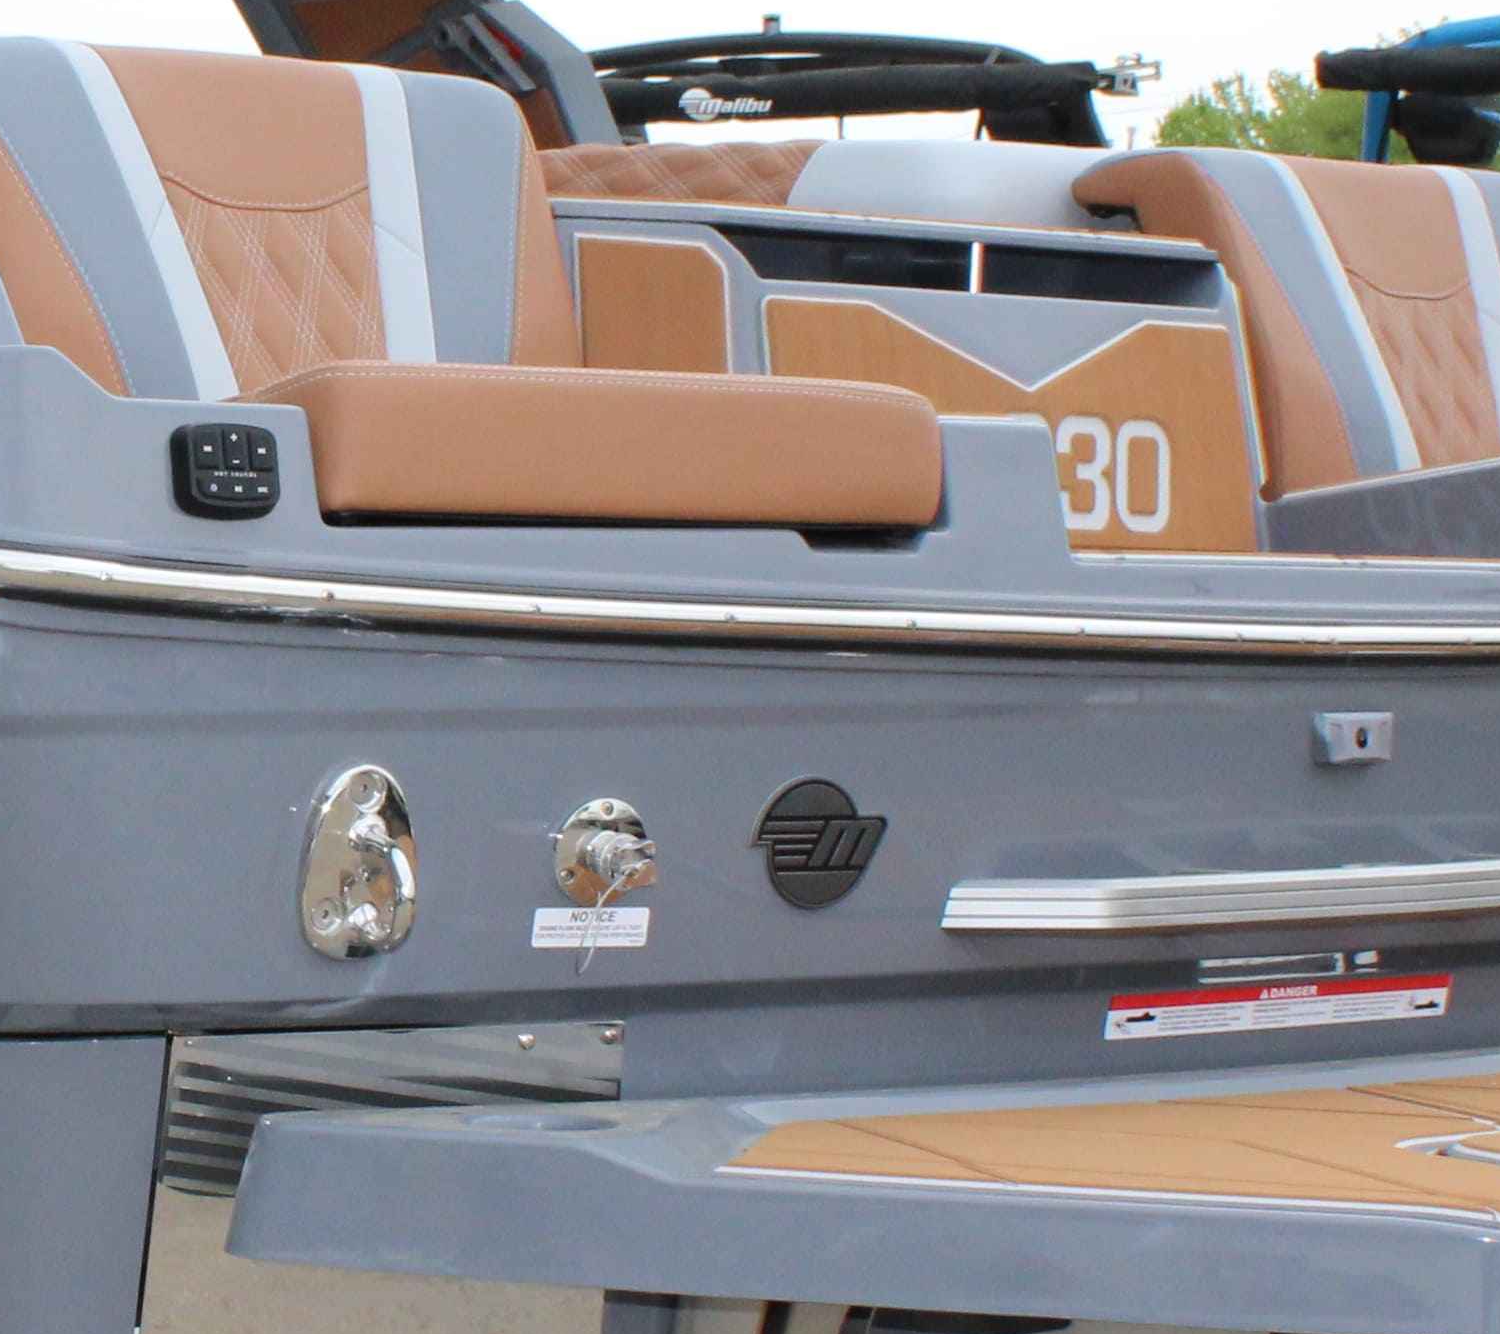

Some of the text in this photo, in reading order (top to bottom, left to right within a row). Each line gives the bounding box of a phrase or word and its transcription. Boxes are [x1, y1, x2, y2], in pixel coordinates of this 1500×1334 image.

[696, 96, 774, 115] Malibu
[1055, 415, 1171, 534] 30
[569, 910, 617, 923] NOTICE
[1270, 985, 1318, 998] DANGER
